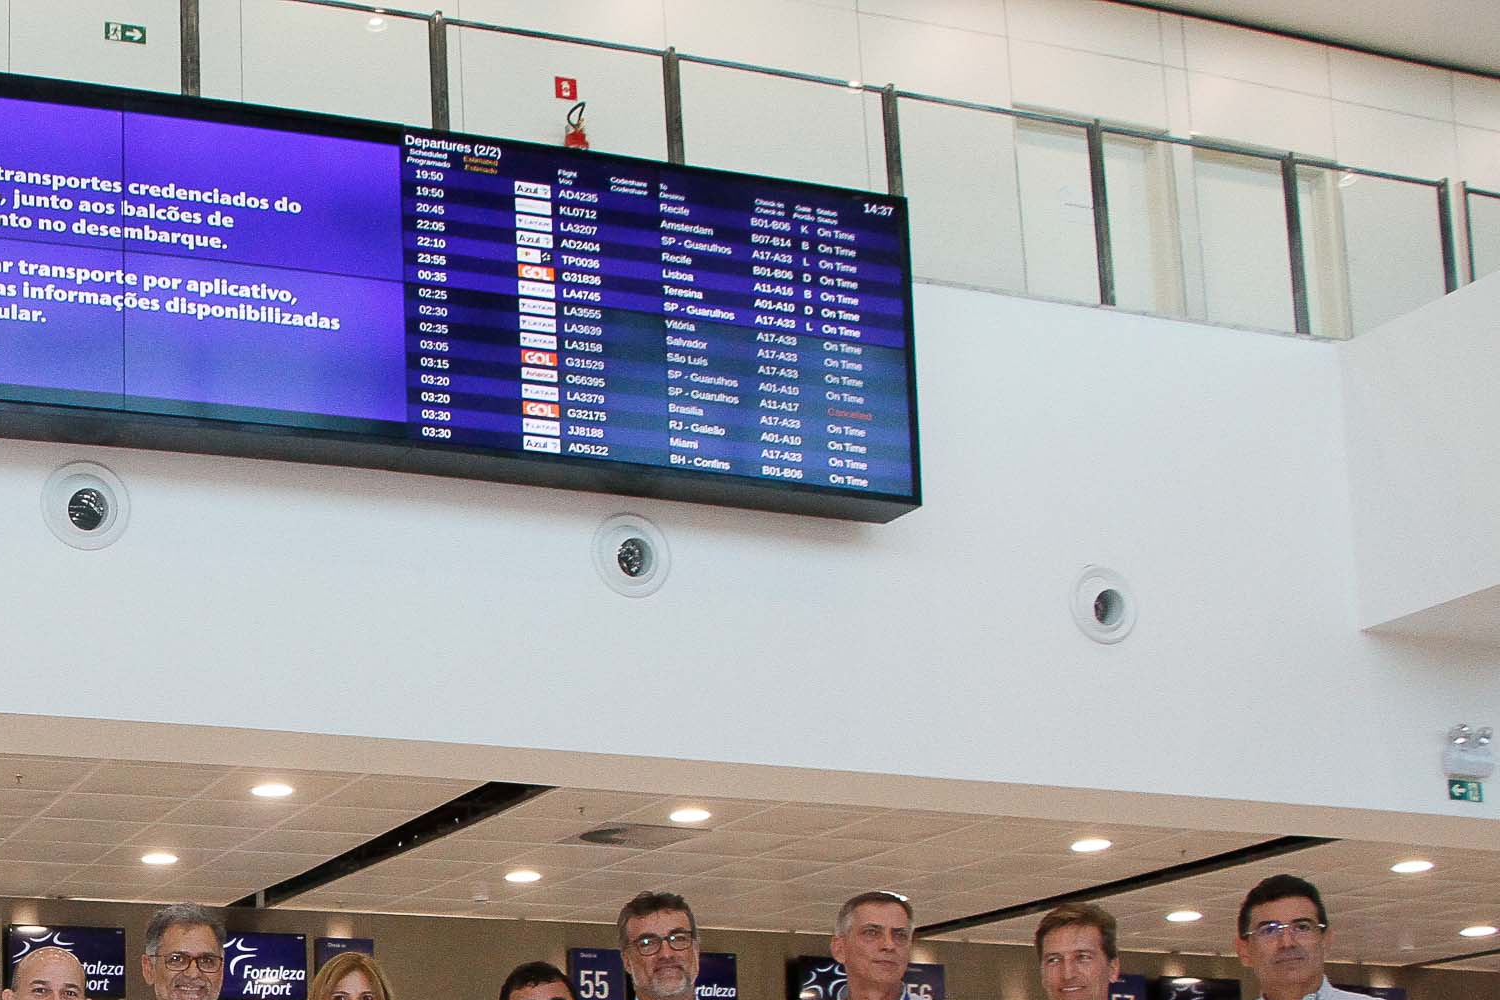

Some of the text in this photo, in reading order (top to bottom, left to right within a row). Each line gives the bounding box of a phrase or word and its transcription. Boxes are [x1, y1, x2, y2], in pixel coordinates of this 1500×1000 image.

[404, 134, 502, 160] Departures (2/2)
[416, 170, 443, 181] 19:50
[128, 182, 269, 210] credenciados
[274, 196, 302, 214] do
[417, 186, 444, 198] 19:50
[12, 188, 73, 211] junto
[78, 200, 116, 215] aos
[123, 199, 202, 225] balcões
[207, 210, 234, 228] de
[417, 203, 444, 215] 20:45
[560, 206, 596, 219] KL0712
[660, 204, 689, 216] Recife
[417, 220, 445, 231] 22:05
[661, 220, 713, 235] Amsterdam
[38, 218, 67, 232] no
[71, 218, 228, 250] desembarque.
[417, 236, 446, 248] 22:10
[561, 239, 600, 252] AD2404
[418, 253, 446, 265] 23:55
[662, 253, 692, 265] Recife
[418, 270, 447, 282] 00:35
[663, 269, 694, 282] Lisboa
[17, 260, 138, 286] transporte
[143, 274, 183, 292] por
[186, 278, 298, 306] aplicativo,
[419, 288, 447, 299] 02:25
[563, 288, 601, 301] LA4745
[663, 285, 703, 299] Teresina
[22, 281, 161, 312] informações
[164, 296, 341, 330] disponibilizadas
[419, 305, 448, 317] 02:30
[420, 322, 448, 334] 02:35
[420, 340, 449, 351] 03:05
[666, 336, 708, 349] Salvador
[421, 357, 449, 369] 03:15
[421, 374, 450, 386] 03:20
[421, 392, 450, 404] 03:20
[567, 392, 605, 404] LA3379
[422, 409, 451, 421] 03:30
[567, 409, 607, 421] G32175
[422, 427, 451, 438] 03:30
[670, 437, 699, 449] Miami
[568, 443, 609, 456] AD5122
[243, 965, 306, 981] Fortaleza
[242, 981, 292, 999] Airport
[580, 970, 609, 999] 55
